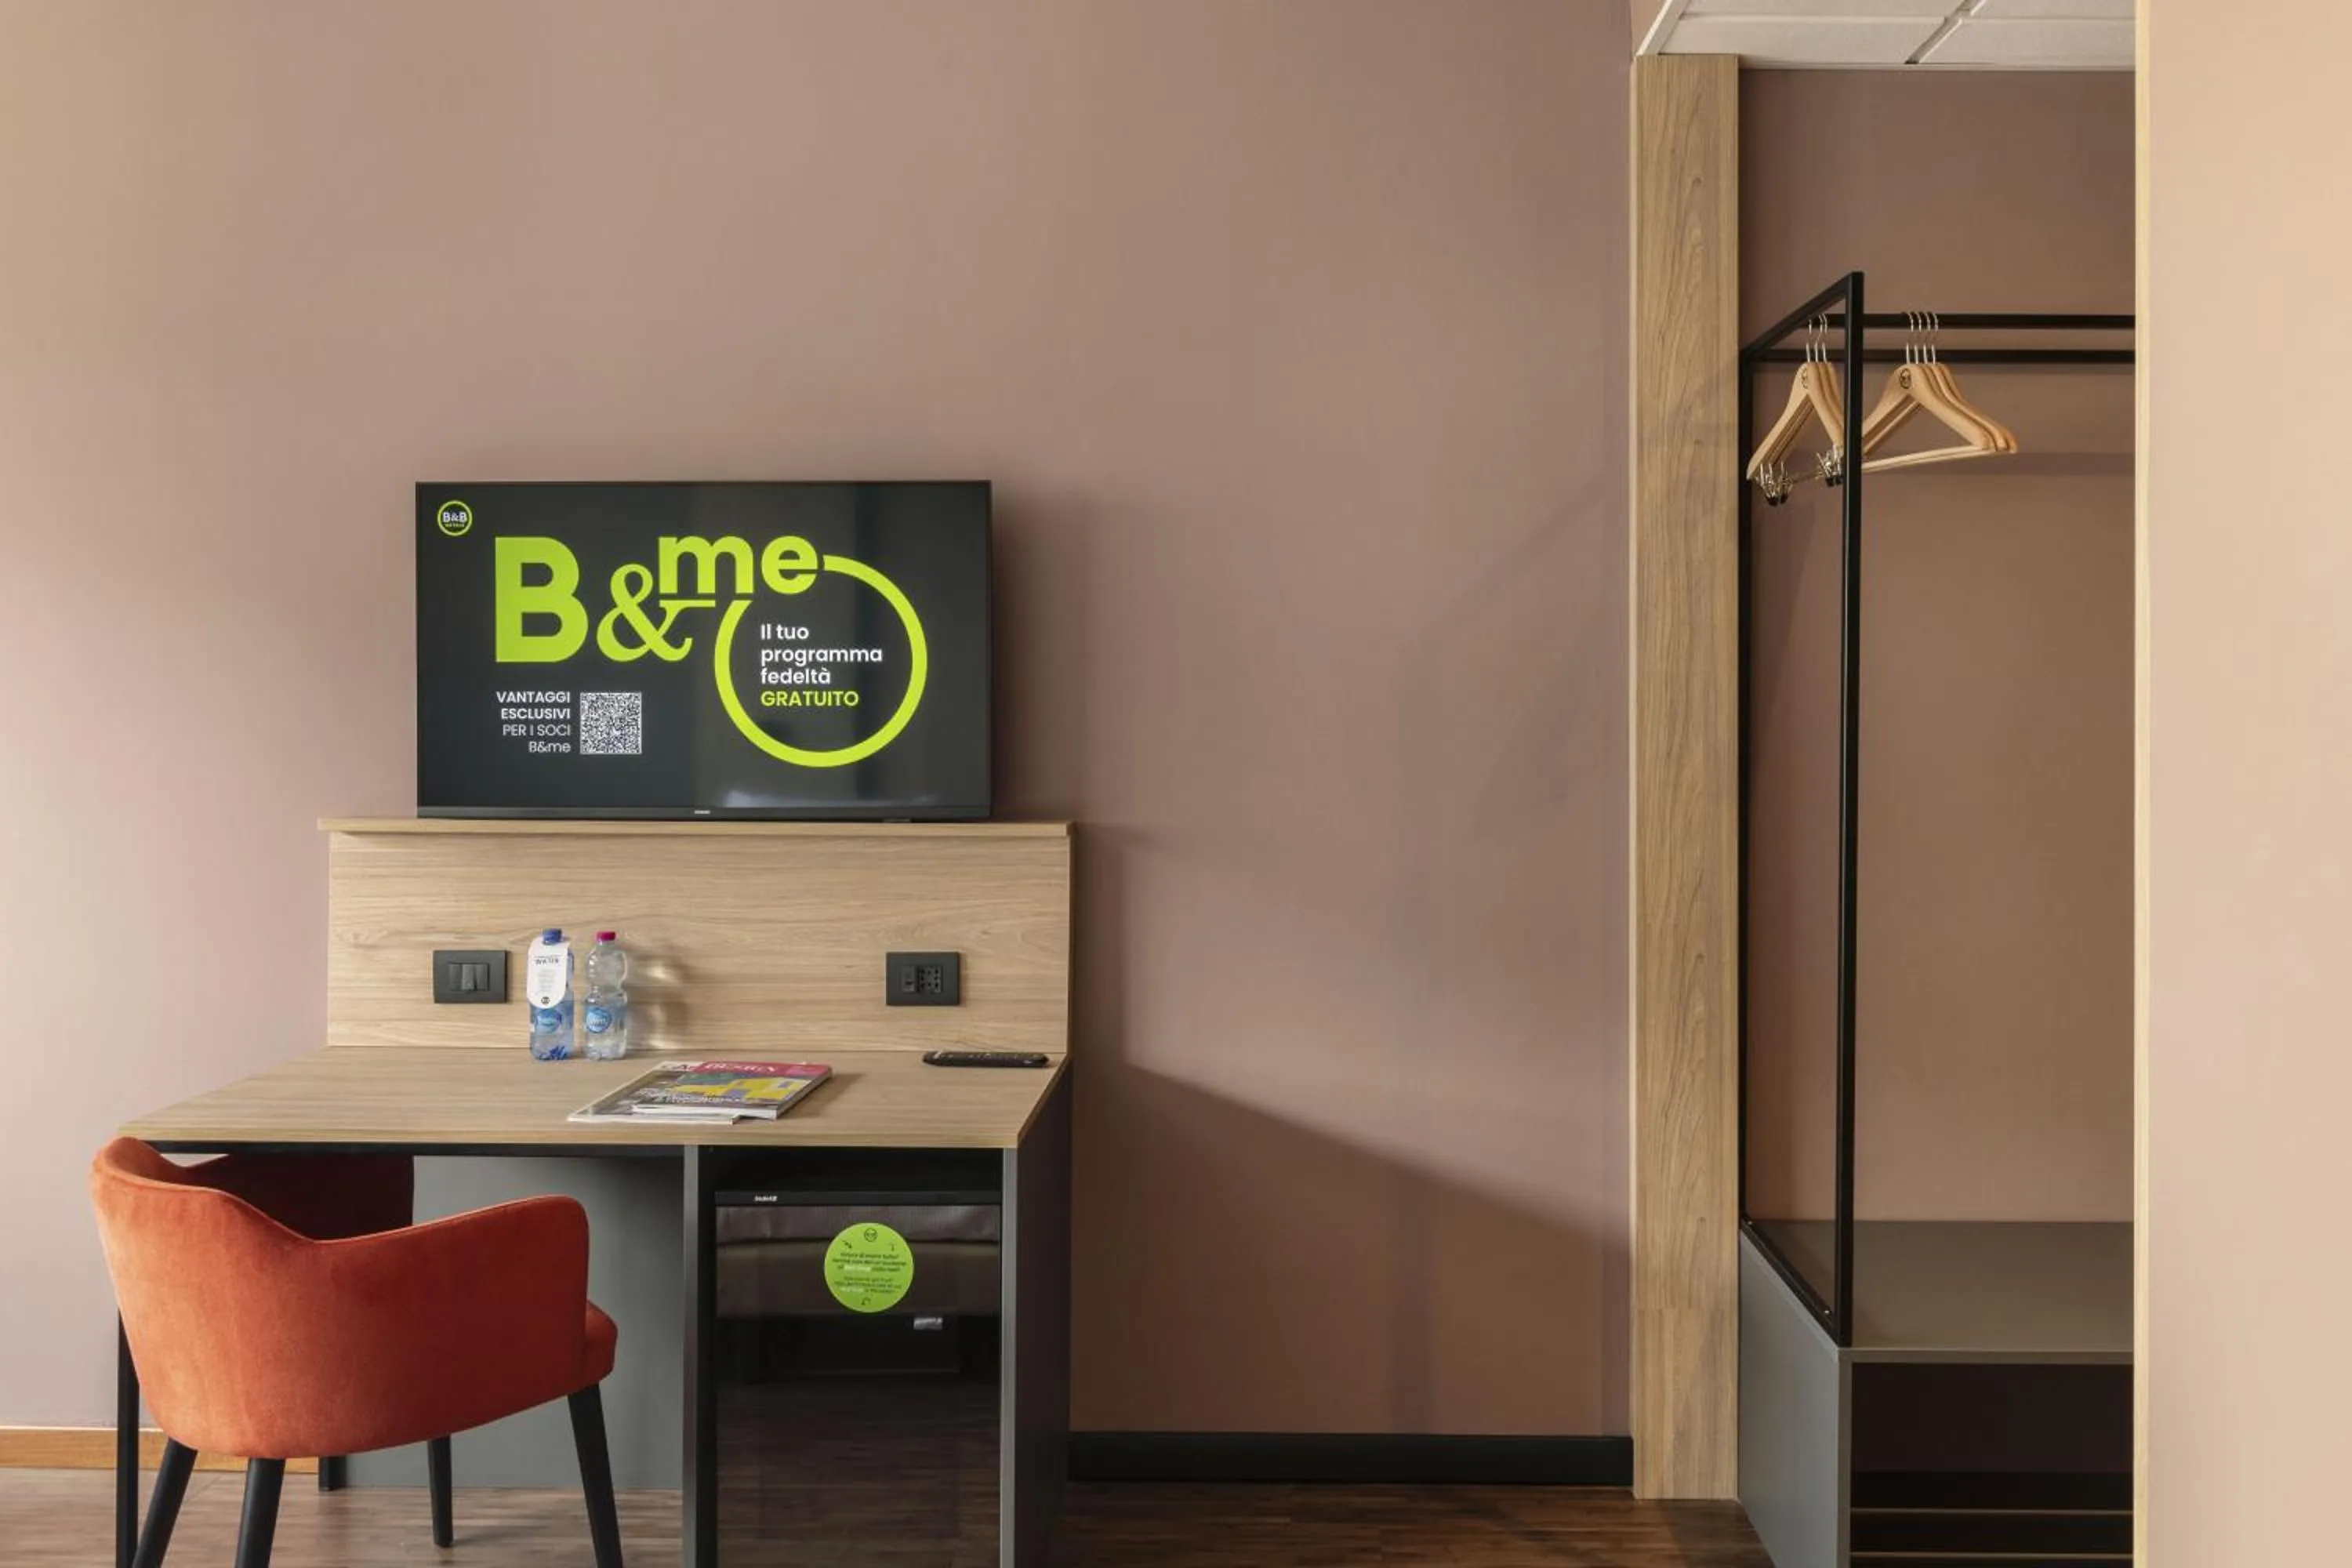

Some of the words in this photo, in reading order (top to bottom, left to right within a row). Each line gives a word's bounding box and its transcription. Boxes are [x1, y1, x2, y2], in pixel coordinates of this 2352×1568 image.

[443, 511, 467, 523] B&B
[760, 623, 772, 640] Il
[775, 624, 809, 640] tuo
[760, 648, 883, 667] programma
[760, 666, 832, 684] fedeltà
[495, 691, 571, 704] VANTAGGI
[760, 690, 859, 707] GRATUITO
[501, 707, 571, 720] ESCLUSIVI
[503, 724, 527, 736] PER
[529, 724, 534, 736] I
[536, 724, 571, 736] SOCI
[528, 740, 572, 753] B&me
